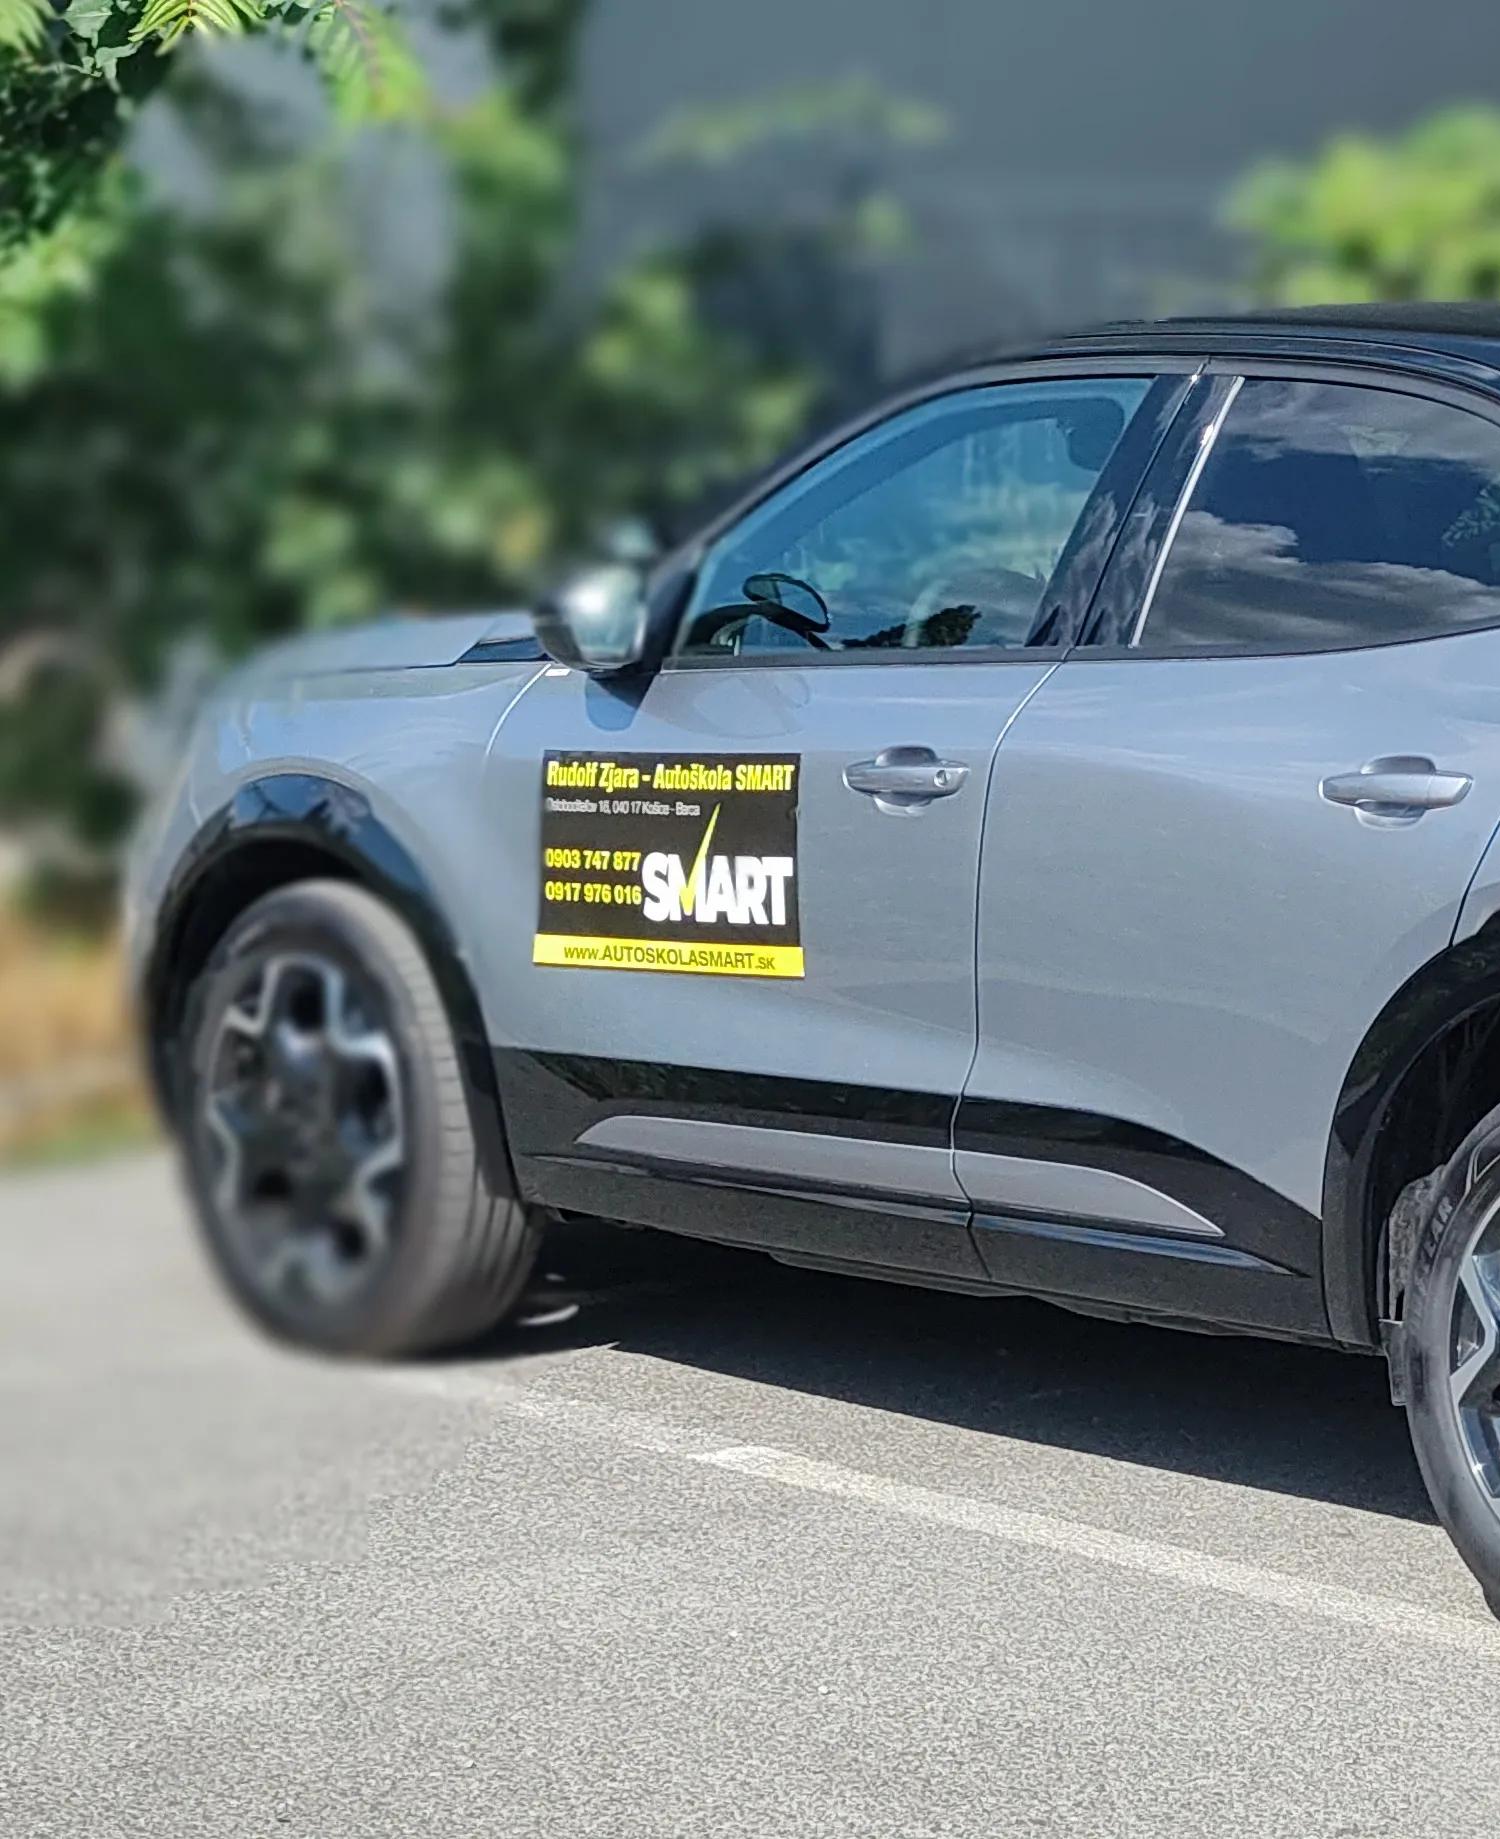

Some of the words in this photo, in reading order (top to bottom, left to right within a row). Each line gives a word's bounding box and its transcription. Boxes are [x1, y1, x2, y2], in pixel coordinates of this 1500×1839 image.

[546, 761, 597, 788] Rudolf
[598, 763, 640, 793] Zjara
[652, 763, 732, 791] Autoškola
[735, 764, 795, 791] SMART
[631, 800, 641, 815] 17
[544, 849, 580, 868] 0903
[582, 850, 610, 870] 747
[612, 851, 641, 871] 877
[544, 881, 580, 901] 0917
[583, 883, 611, 903] 976
[613, 885, 642, 904] 016
[641, 851, 793, 925] SMART
